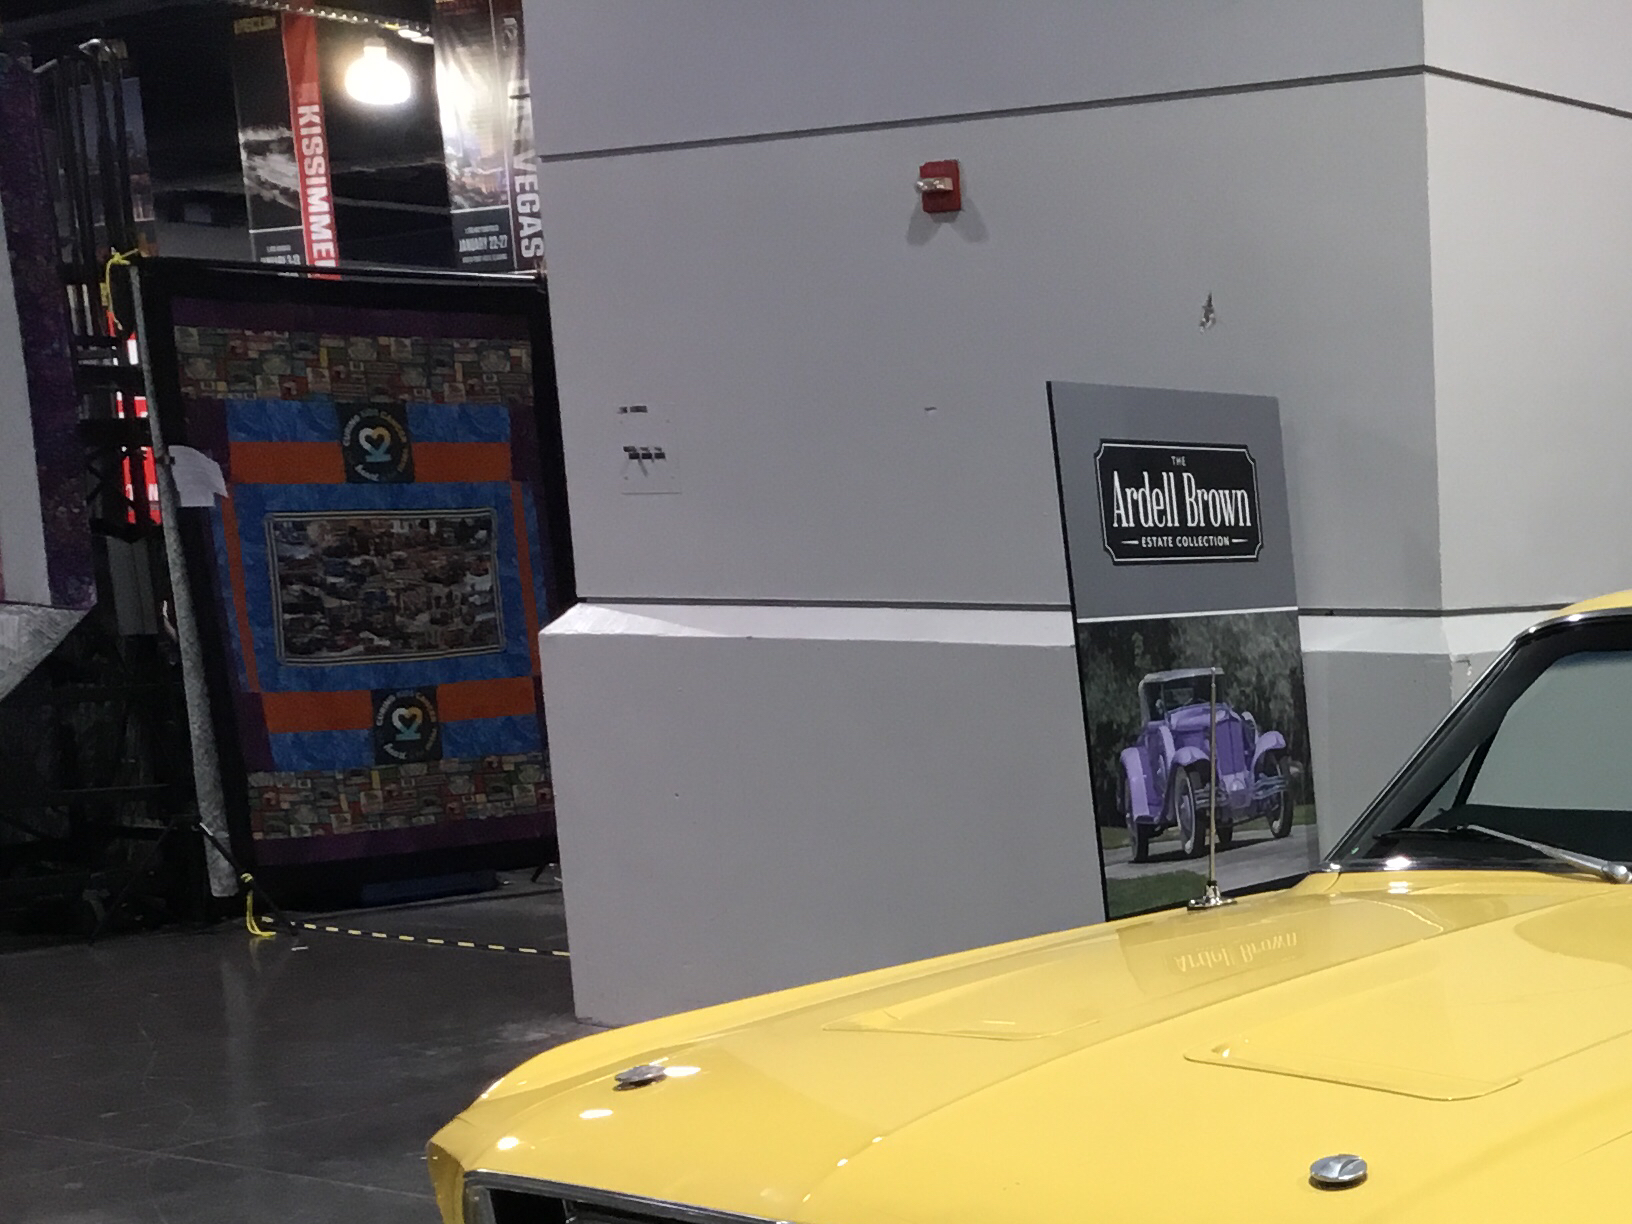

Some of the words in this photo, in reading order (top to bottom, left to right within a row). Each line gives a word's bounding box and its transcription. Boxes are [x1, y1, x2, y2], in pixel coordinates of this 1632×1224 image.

[297, 104, 338, 268] KISSIMME
[513, 153, 545, 258] VEGAS
[1170, 455, 1187, 467] THE
[1112, 470, 1180, 528] Ardell
[1182, 472, 1252, 528] Brown
[1141, 536, 1174, 548] ESTATE
[1176, 535, 1230, 547] COLLECTION
